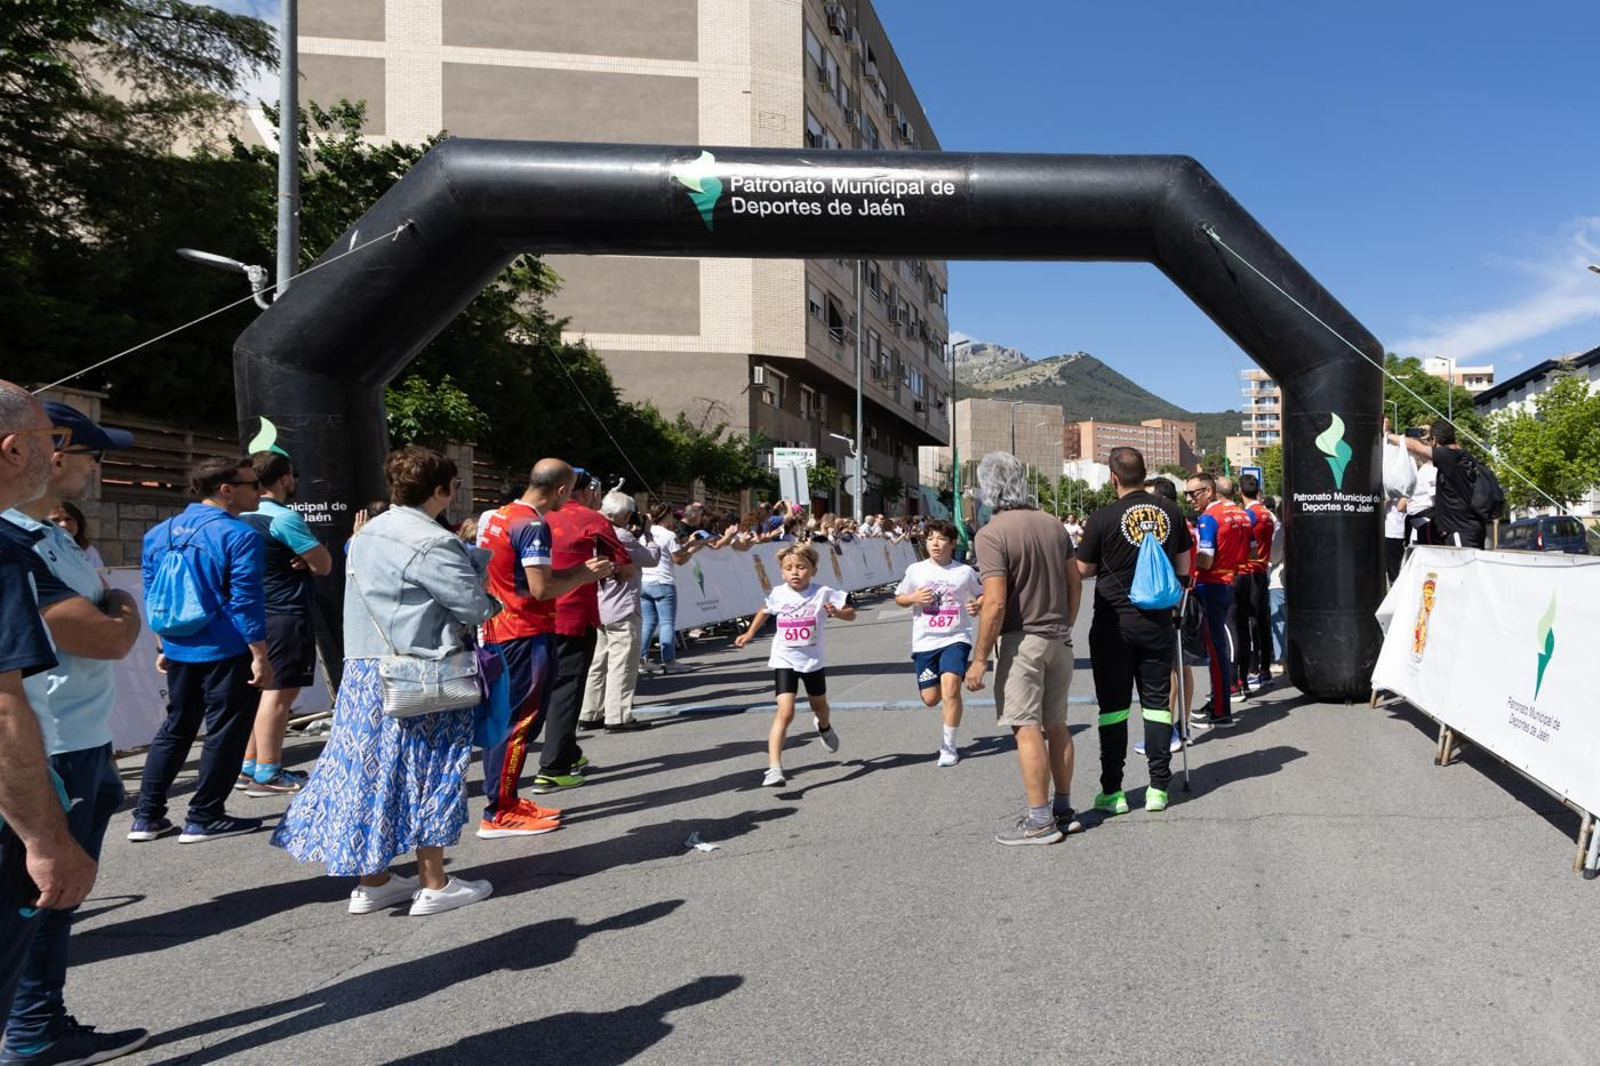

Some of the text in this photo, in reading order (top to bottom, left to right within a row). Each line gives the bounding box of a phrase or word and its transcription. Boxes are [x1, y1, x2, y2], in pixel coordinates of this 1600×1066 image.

[730, 176, 956, 199] Patronato Municipal de
[731, 197, 906, 218] Deportes de Jaén
[1293, 493, 1332, 502] Patronato
[1334, 492, 1373, 504] Municipal
[286, 502, 347, 513] nicipal de
[1302, 503, 1375, 513] Deportes de Jaén
[928, 616, 954, 628] 687
[784, 627, 811, 641] 610
